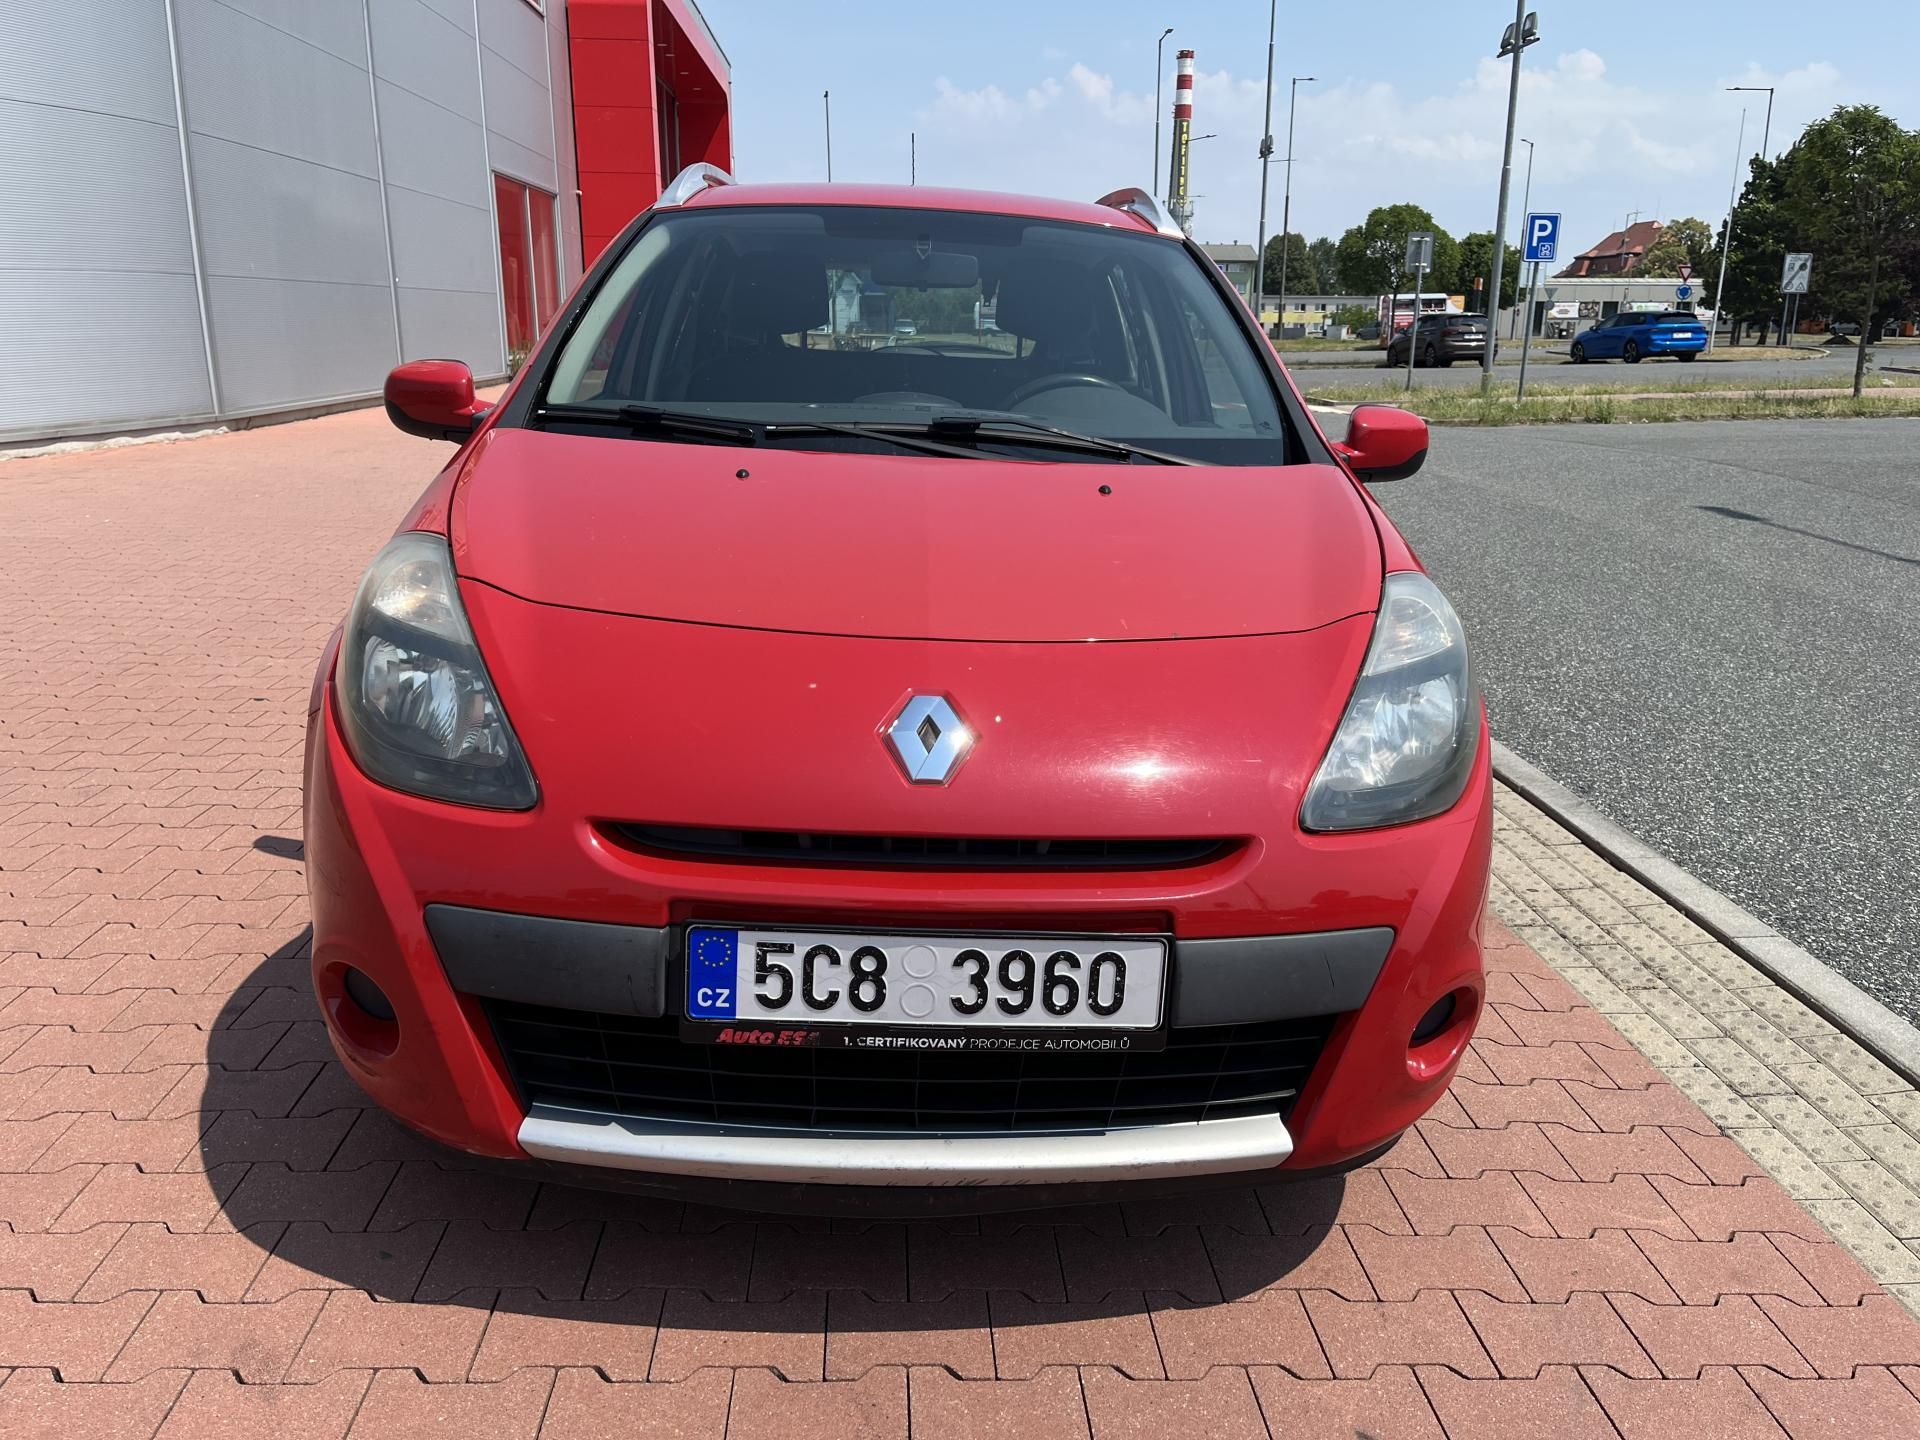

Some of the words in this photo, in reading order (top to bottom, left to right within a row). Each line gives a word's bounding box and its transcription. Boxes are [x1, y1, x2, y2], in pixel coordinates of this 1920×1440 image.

[1532, 219, 1552, 247] P
[755, 942, 888, 1012] 5C8
[950, 949, 1126, 1016] 3960
[697, 987, 730, 1008] CZ
[716, 1028, 775, 1045] Auto
[843, 1036, 853, 1046] 1.
[857, 1036, 966, 1049] CERTIFIKOVANÝ
[970, 1038, 1041, 1050] PRODEJCE
[1044, 1036, 1130, 1050] AUTOMOBILŮ
